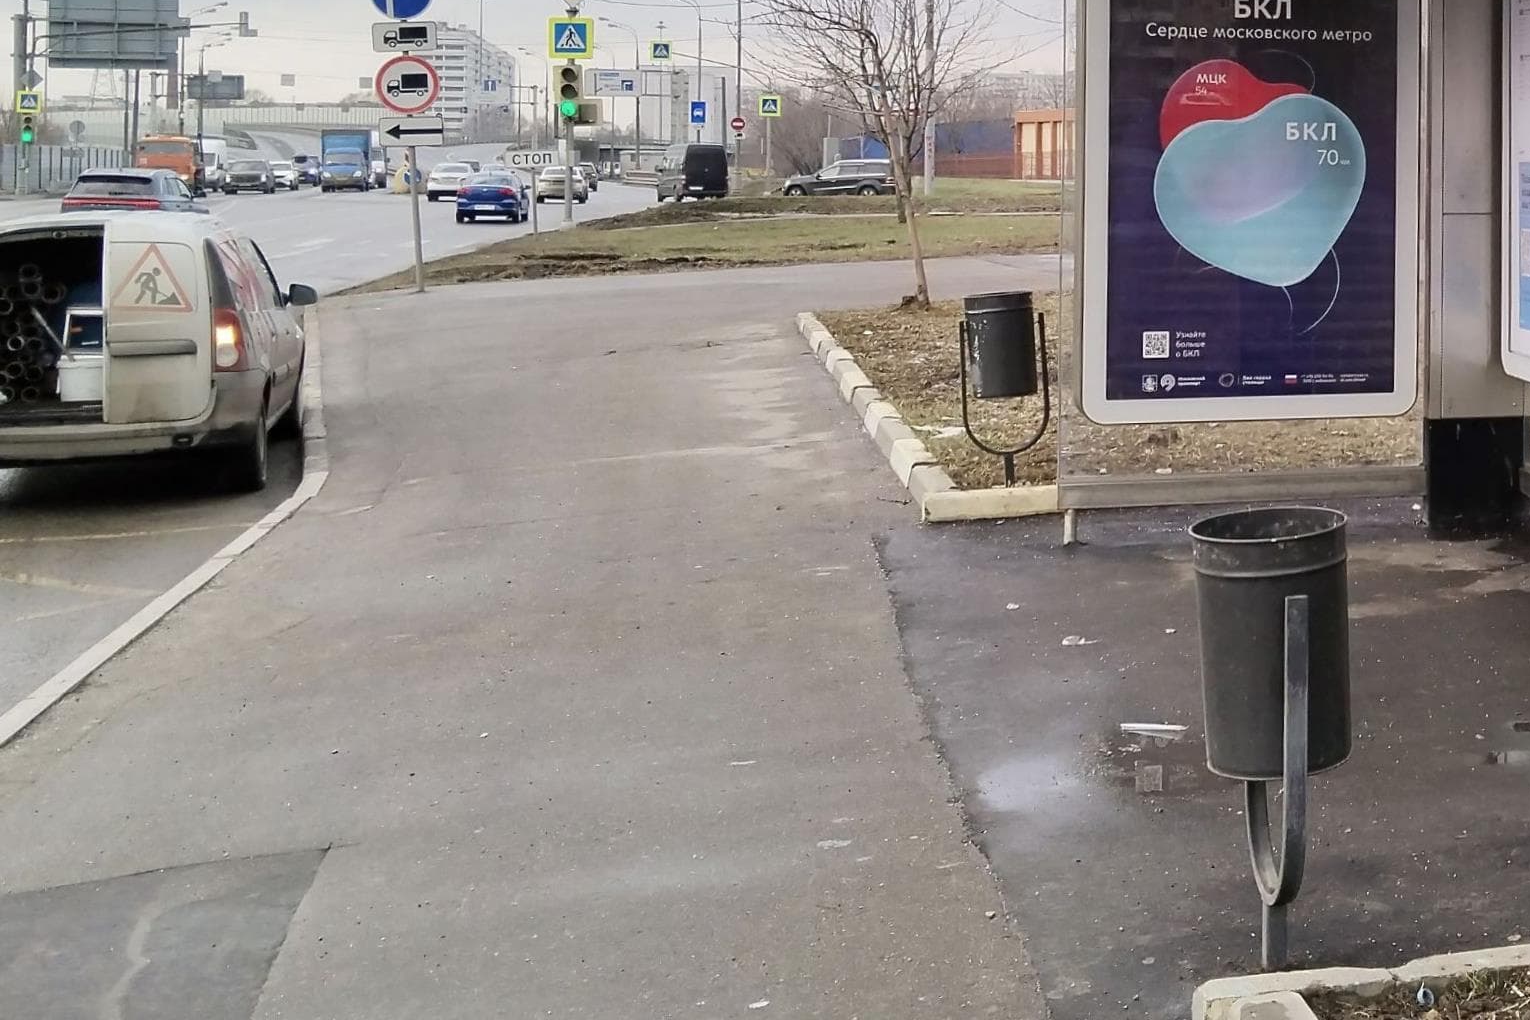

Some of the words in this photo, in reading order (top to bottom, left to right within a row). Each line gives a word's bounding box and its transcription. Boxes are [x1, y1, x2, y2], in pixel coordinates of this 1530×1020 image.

[1145, 22, 1208, 40] Сердце
[1213, 27, 1317, 41] московского
[1322, 30, 1373, 44] метро
[1196, 73, 1227, 85] МЦК
[1195, 86, 1207, 95] 54
[1286, 122, 1337, 141] БКЛ
[512, 153, 552, 165] СТОП
[1317, 149, 1339, 166] 70
[1175, 331, 1206, 339] Узнайте
[1183, 349, 1200, 357] БКЛ
